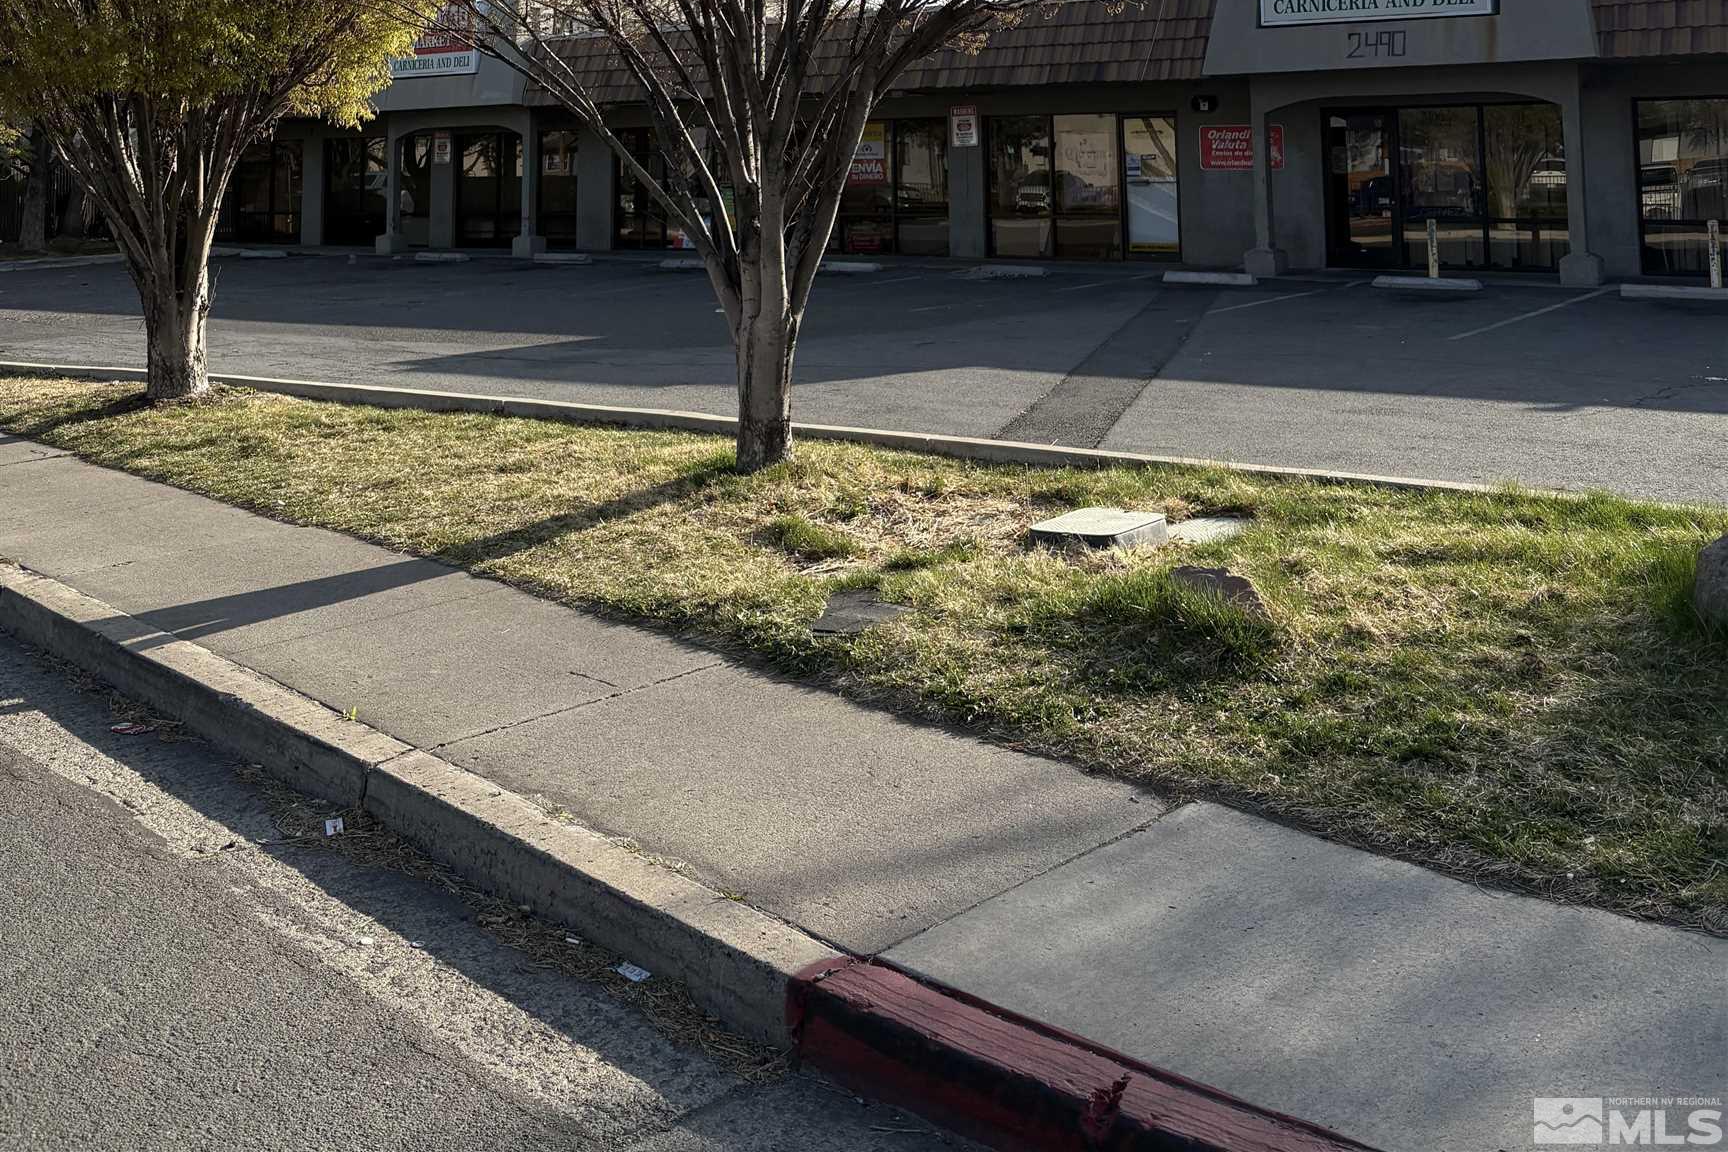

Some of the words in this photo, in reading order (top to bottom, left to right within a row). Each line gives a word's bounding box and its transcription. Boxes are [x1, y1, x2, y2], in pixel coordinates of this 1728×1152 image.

[1345, 30, 1407, 59] 2490
[436, 57, 451, 69] AND
[453, 55, 470, 67] DELI
